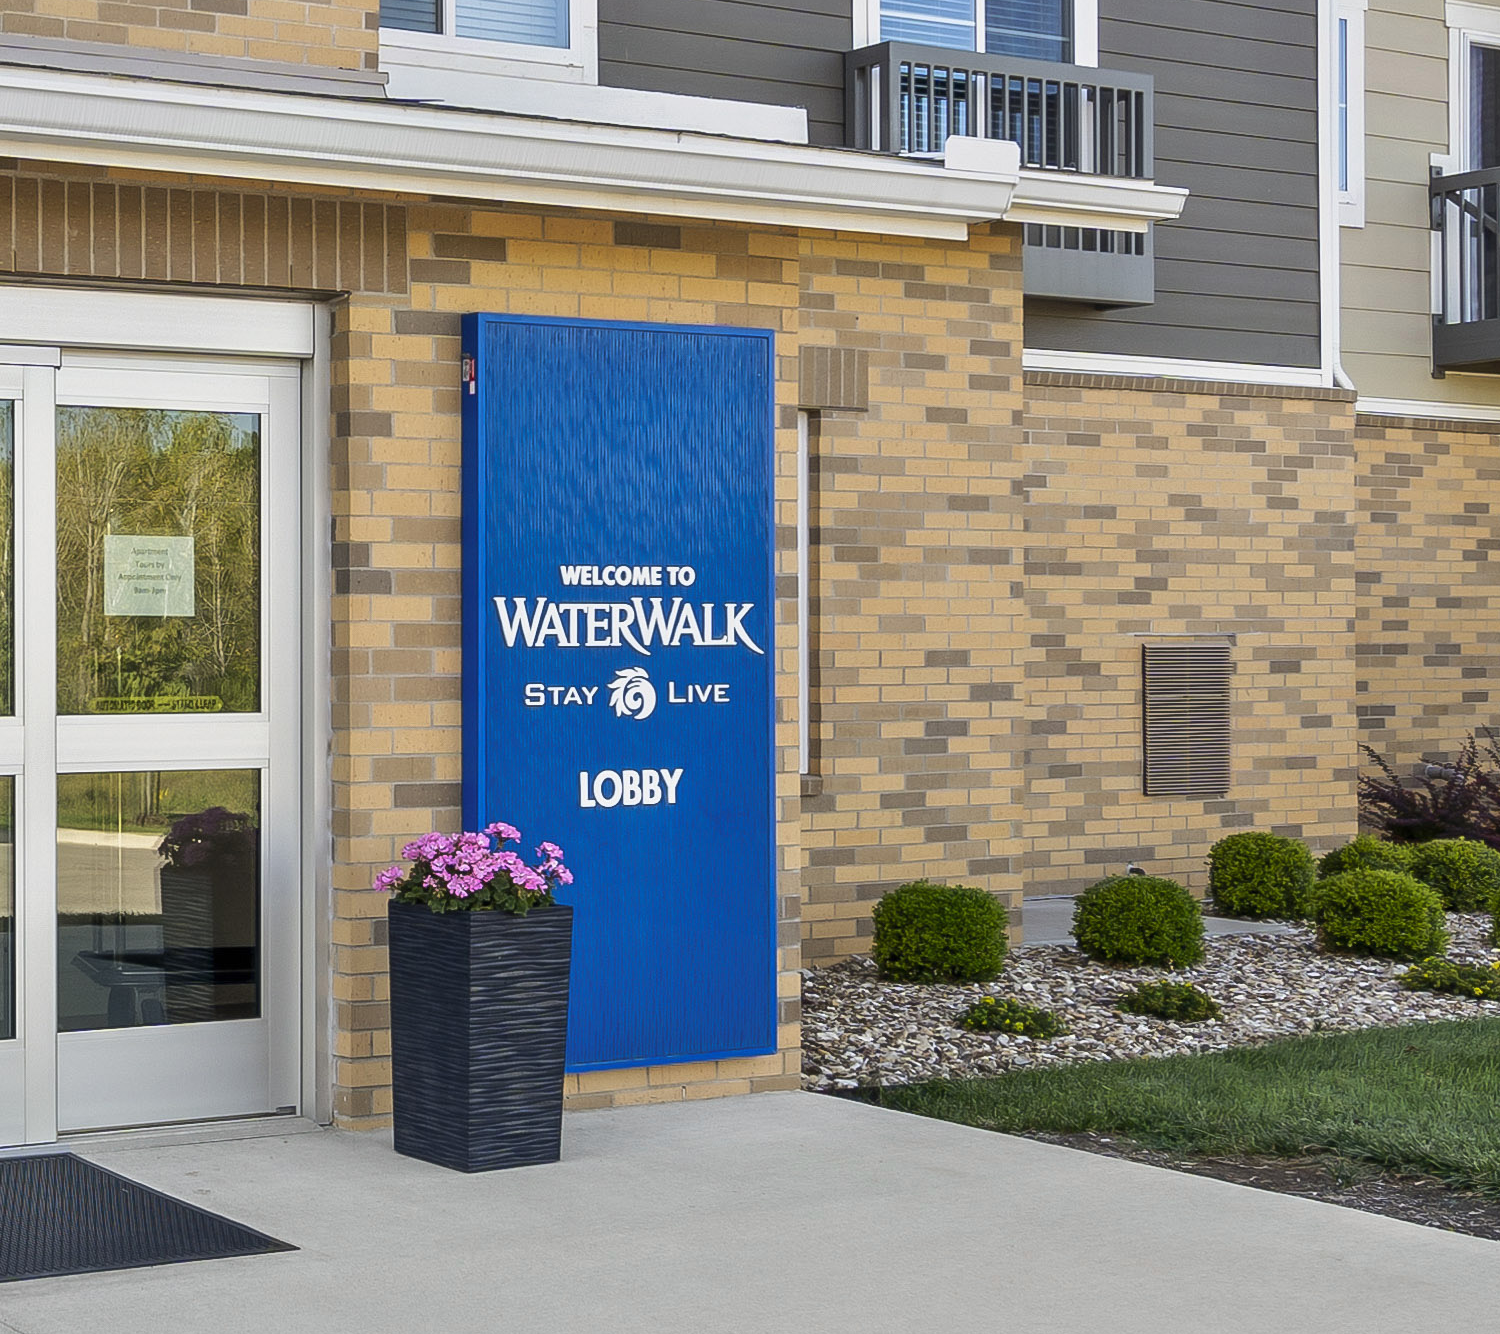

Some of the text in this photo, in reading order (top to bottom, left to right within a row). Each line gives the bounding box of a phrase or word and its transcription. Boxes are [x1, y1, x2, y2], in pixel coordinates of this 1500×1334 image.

[131, 547, 168, 556] Apartment
[117, 573, 164, 582] Appointment
[560, 565, 696, 586] WELCOME TO
[493, 596, 764, 656] WATERWALK
[524, 681, 730, 705] STAY LIVE
[579, 768, 684, 808] LOBBY
